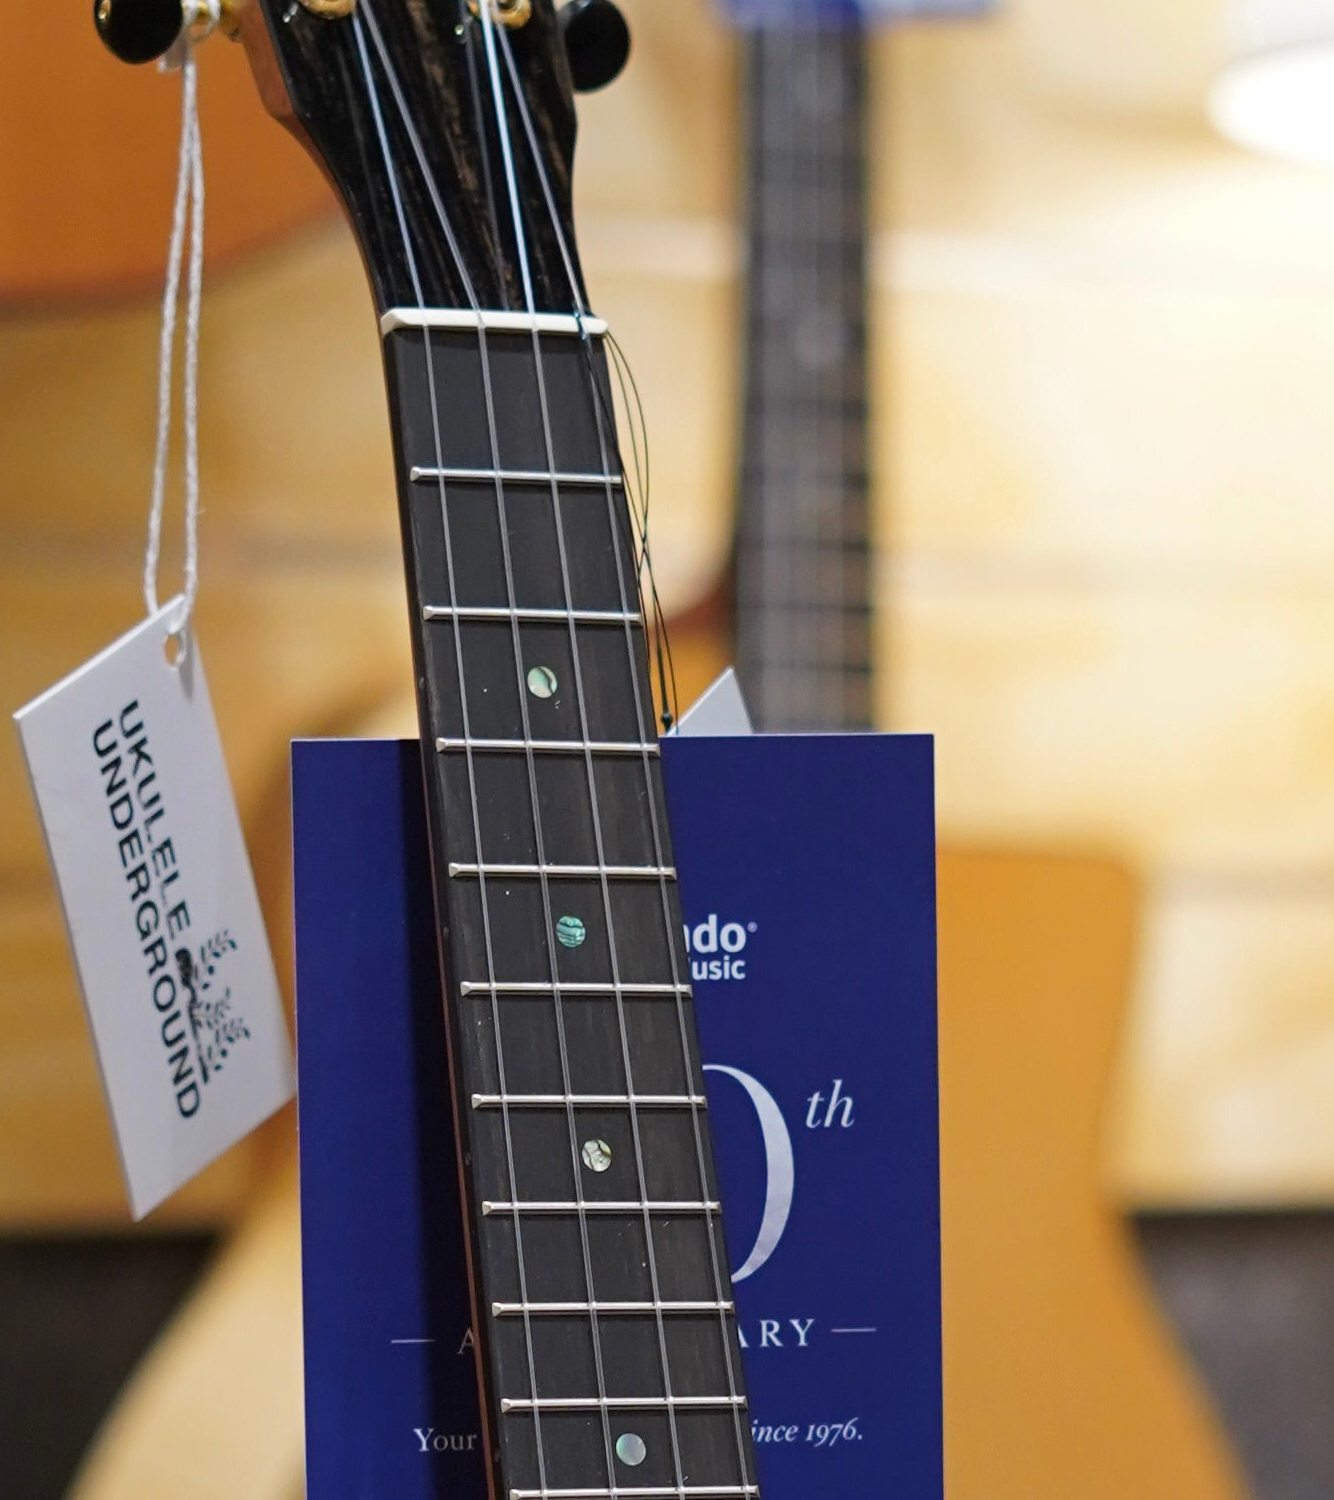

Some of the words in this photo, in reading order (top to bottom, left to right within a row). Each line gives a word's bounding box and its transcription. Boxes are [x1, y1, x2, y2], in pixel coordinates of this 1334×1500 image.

[119, 699, 191, 941] UKULELE
[91, 718, 202, 1120] UNDERGROUND
[689, 955, 747, 981] usic
[412, 1427, 478, 1453] Your
[750, 1419, 799, 1443] ince
[804, 1416, 864, 1448] 1976.
